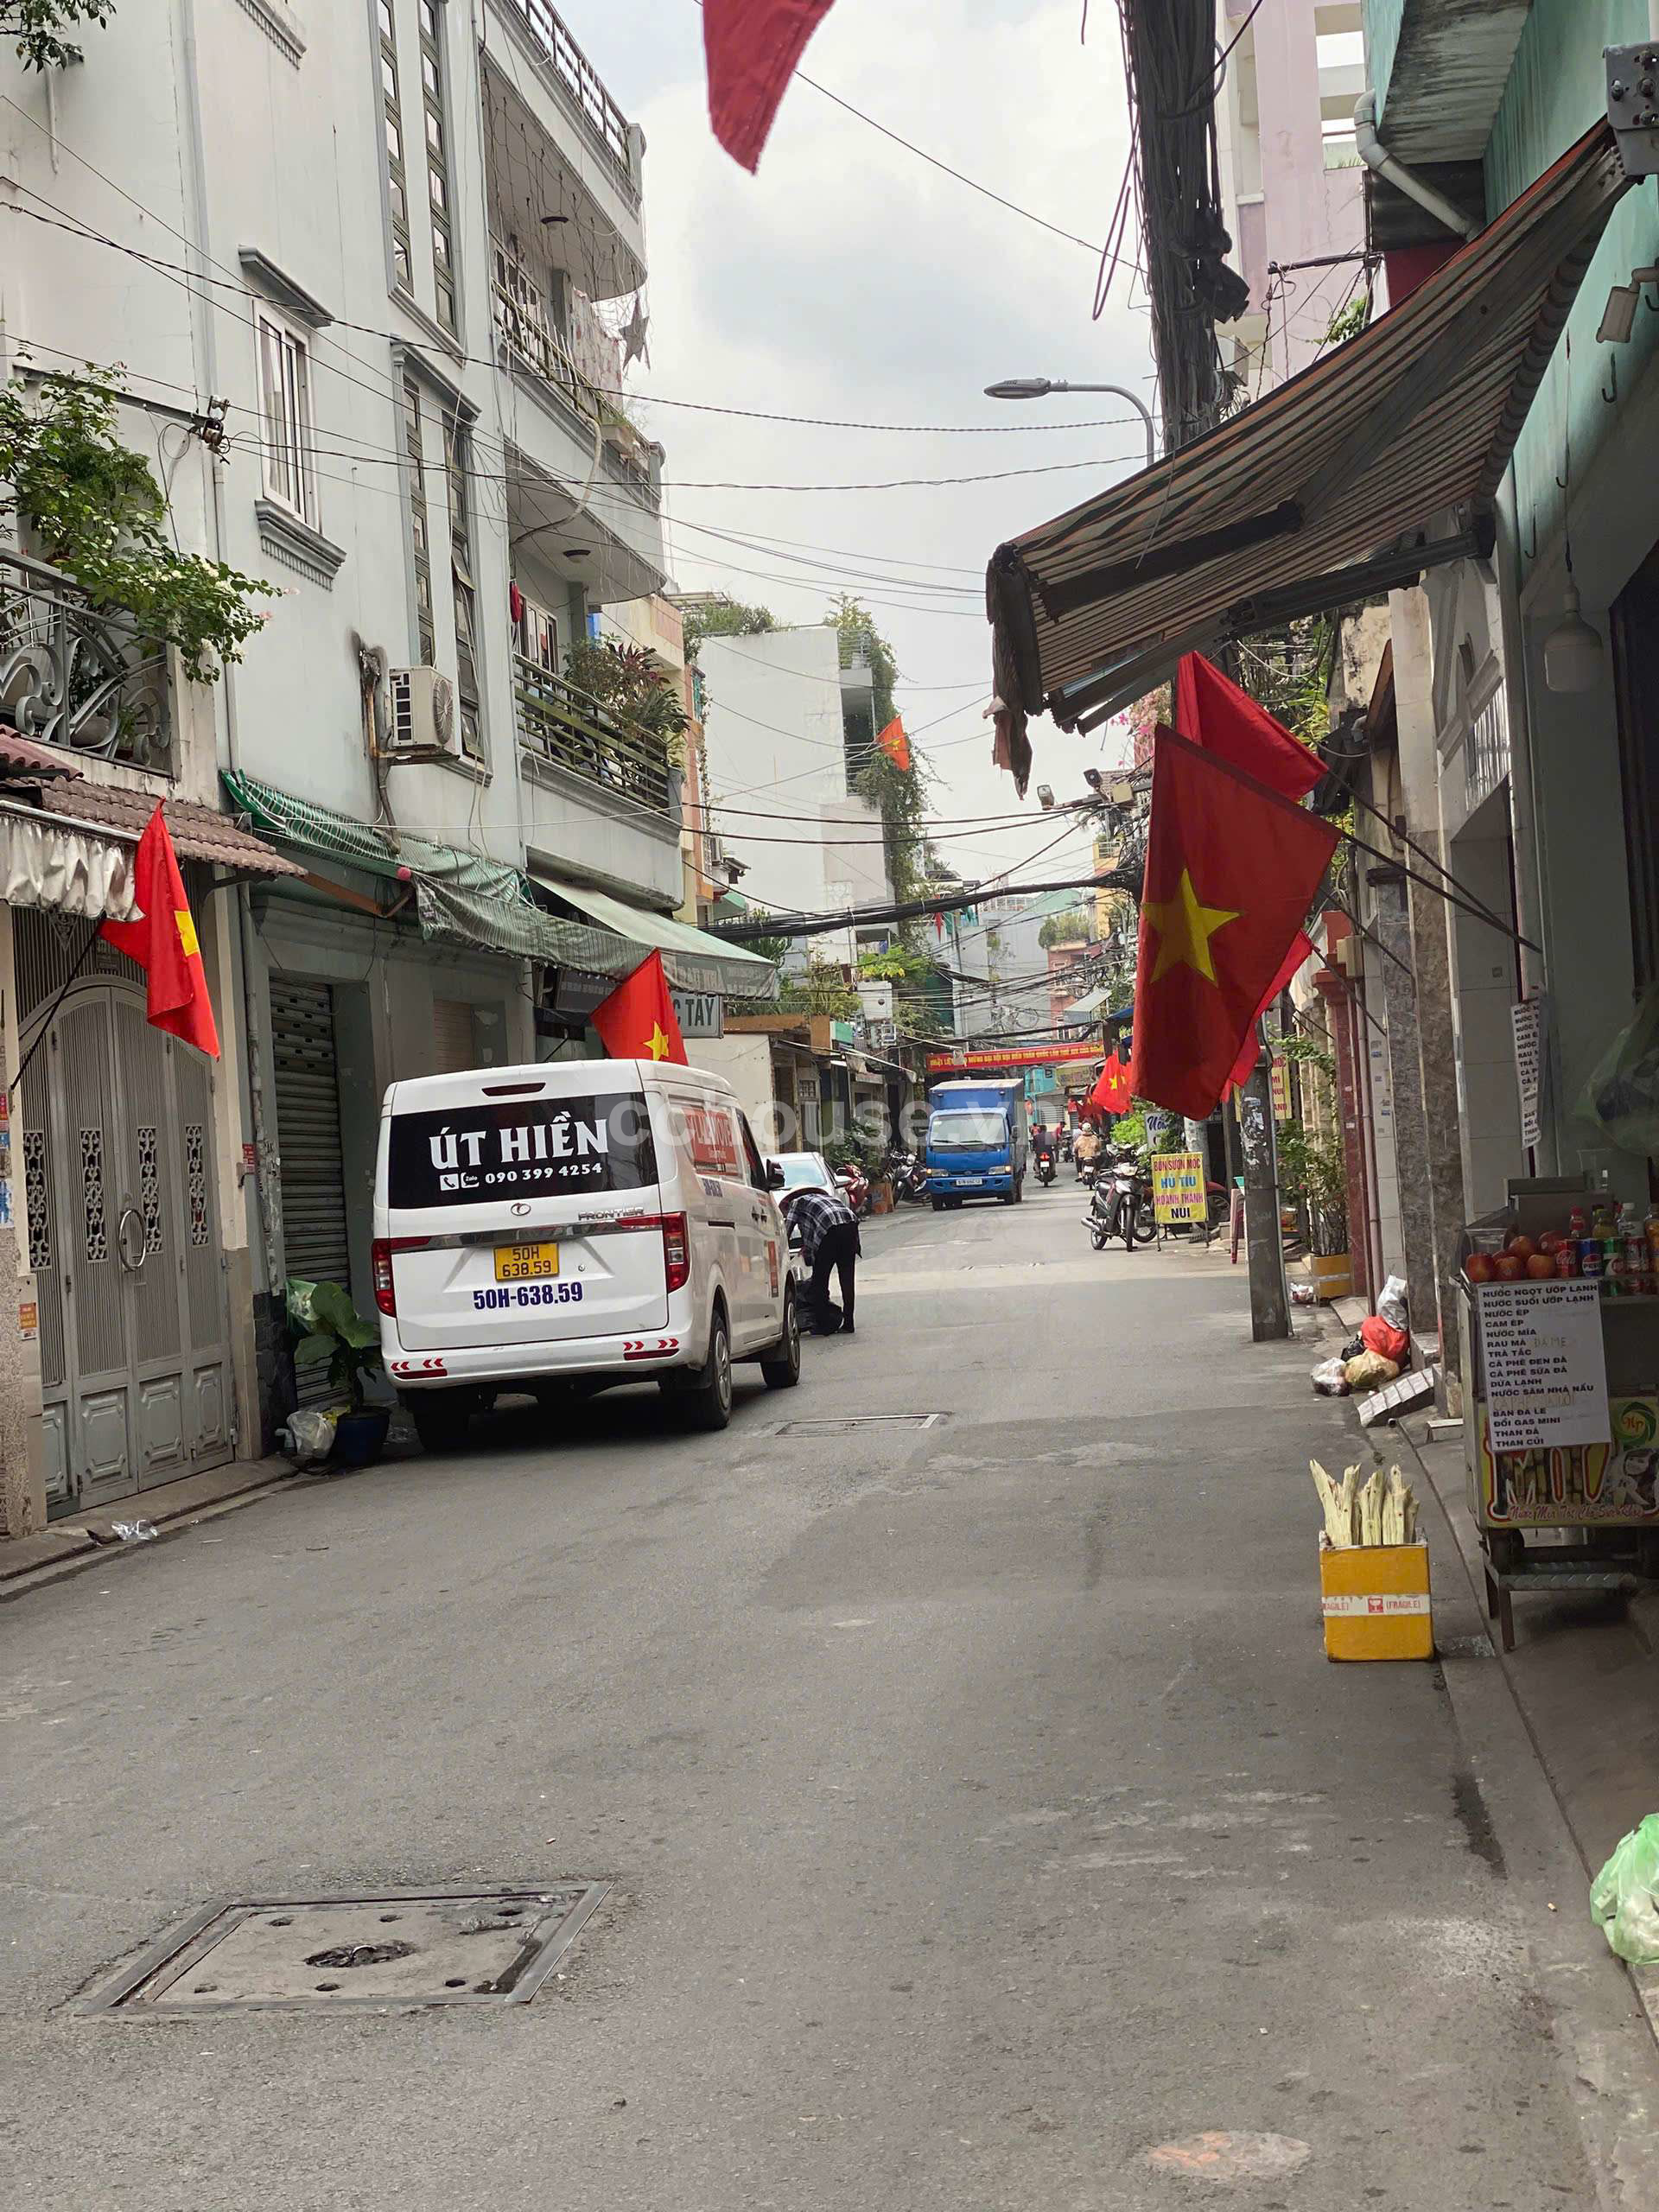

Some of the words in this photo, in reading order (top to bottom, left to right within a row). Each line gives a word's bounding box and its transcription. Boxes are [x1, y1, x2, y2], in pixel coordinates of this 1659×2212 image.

[429, 1127, 486, 1169] ÚT
[499, 1111, 609, 1163] HIỀN
[485, 1171, 518, 1184] 090
[522, 1167, 554, 1181] 399
[558, 1162, 602, 1177] 4254
[578, 1206, 645, 1221] FRONTIER
[1171, 1207, 1191, 1219] NUI
[512, 1246, 540, 1262] 50H
[502, 1261, 552, 1277] 638.59
[473, 1281, 583, 1310] 50H-638.59
[1483, 1288, 1511, 1298] NƯỚC
[1514, 1287, 1542, 1296] NGỌT
[1569, 1284, 1598, 1294] LẠNH
[1484, 1299, 1512, 1308] NƯỚC
[1566, 1294, 1594, 1305] LẠNH
[1484, 1309, 1513, 1319] NƯỚC
[1538, 1416, 1560, 1425] MINI
